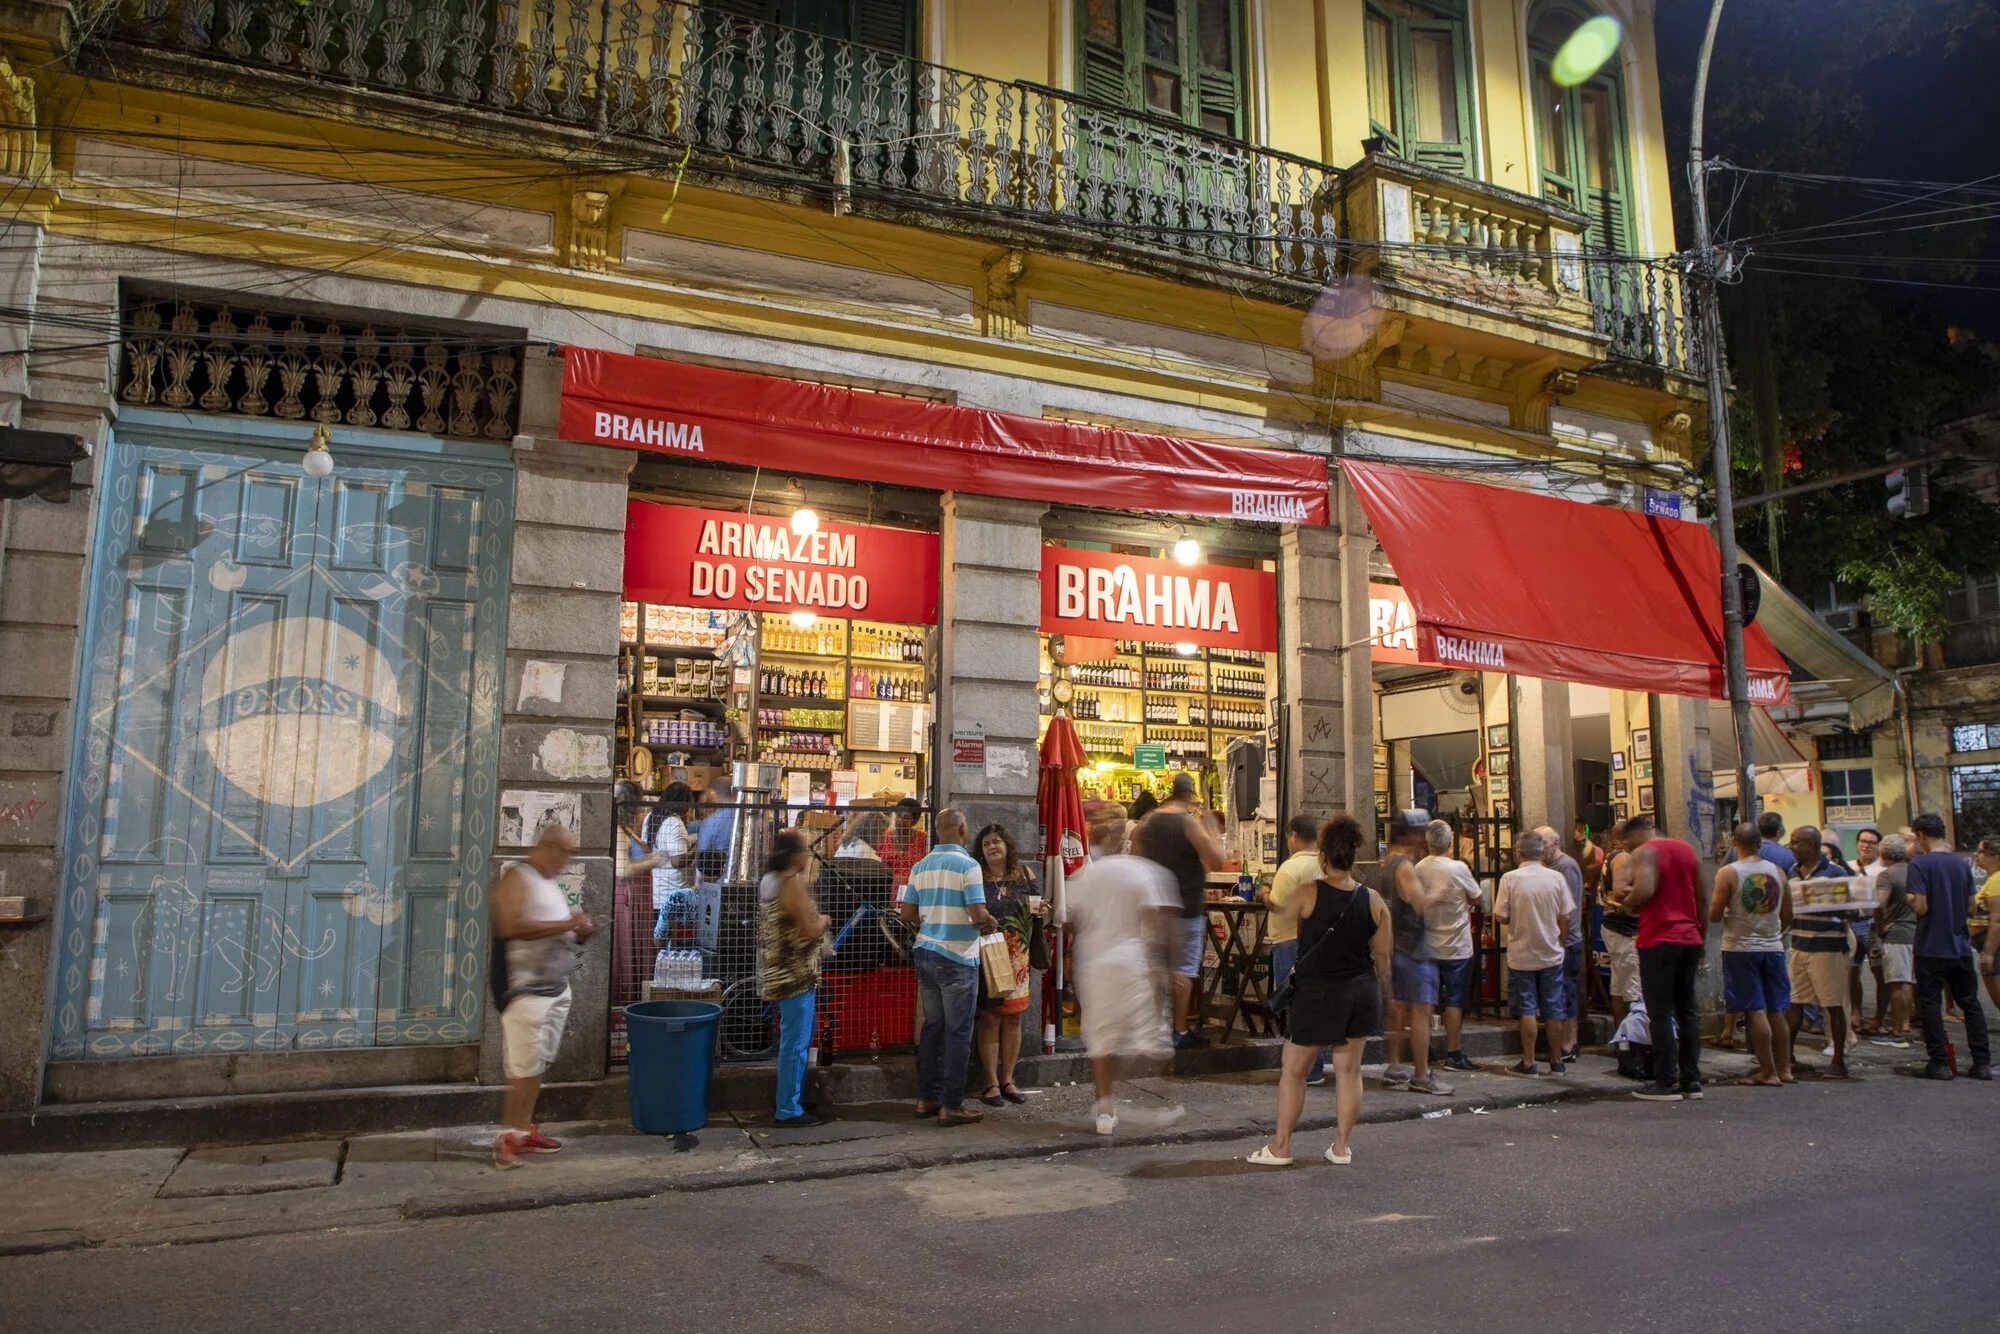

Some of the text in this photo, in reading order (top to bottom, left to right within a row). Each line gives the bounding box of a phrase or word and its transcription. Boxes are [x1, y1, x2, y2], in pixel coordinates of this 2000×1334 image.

[594, 411, 705, 452] BRAHMA
[1232, 491, 1308, 519] BRAHMA
[1648, 500, 1679, 518] SENADO
[698, 519, 856, 568] ARMAZEM
[692, 560, 868, 610] DO SENADO
[1057, 564, 1240, 633] BRAHMA
[1436, 634, 1505, 667] BRAHMA
[1747, 678, 1777, 699] HMA
[955, 740, 983, 749] Alarme
